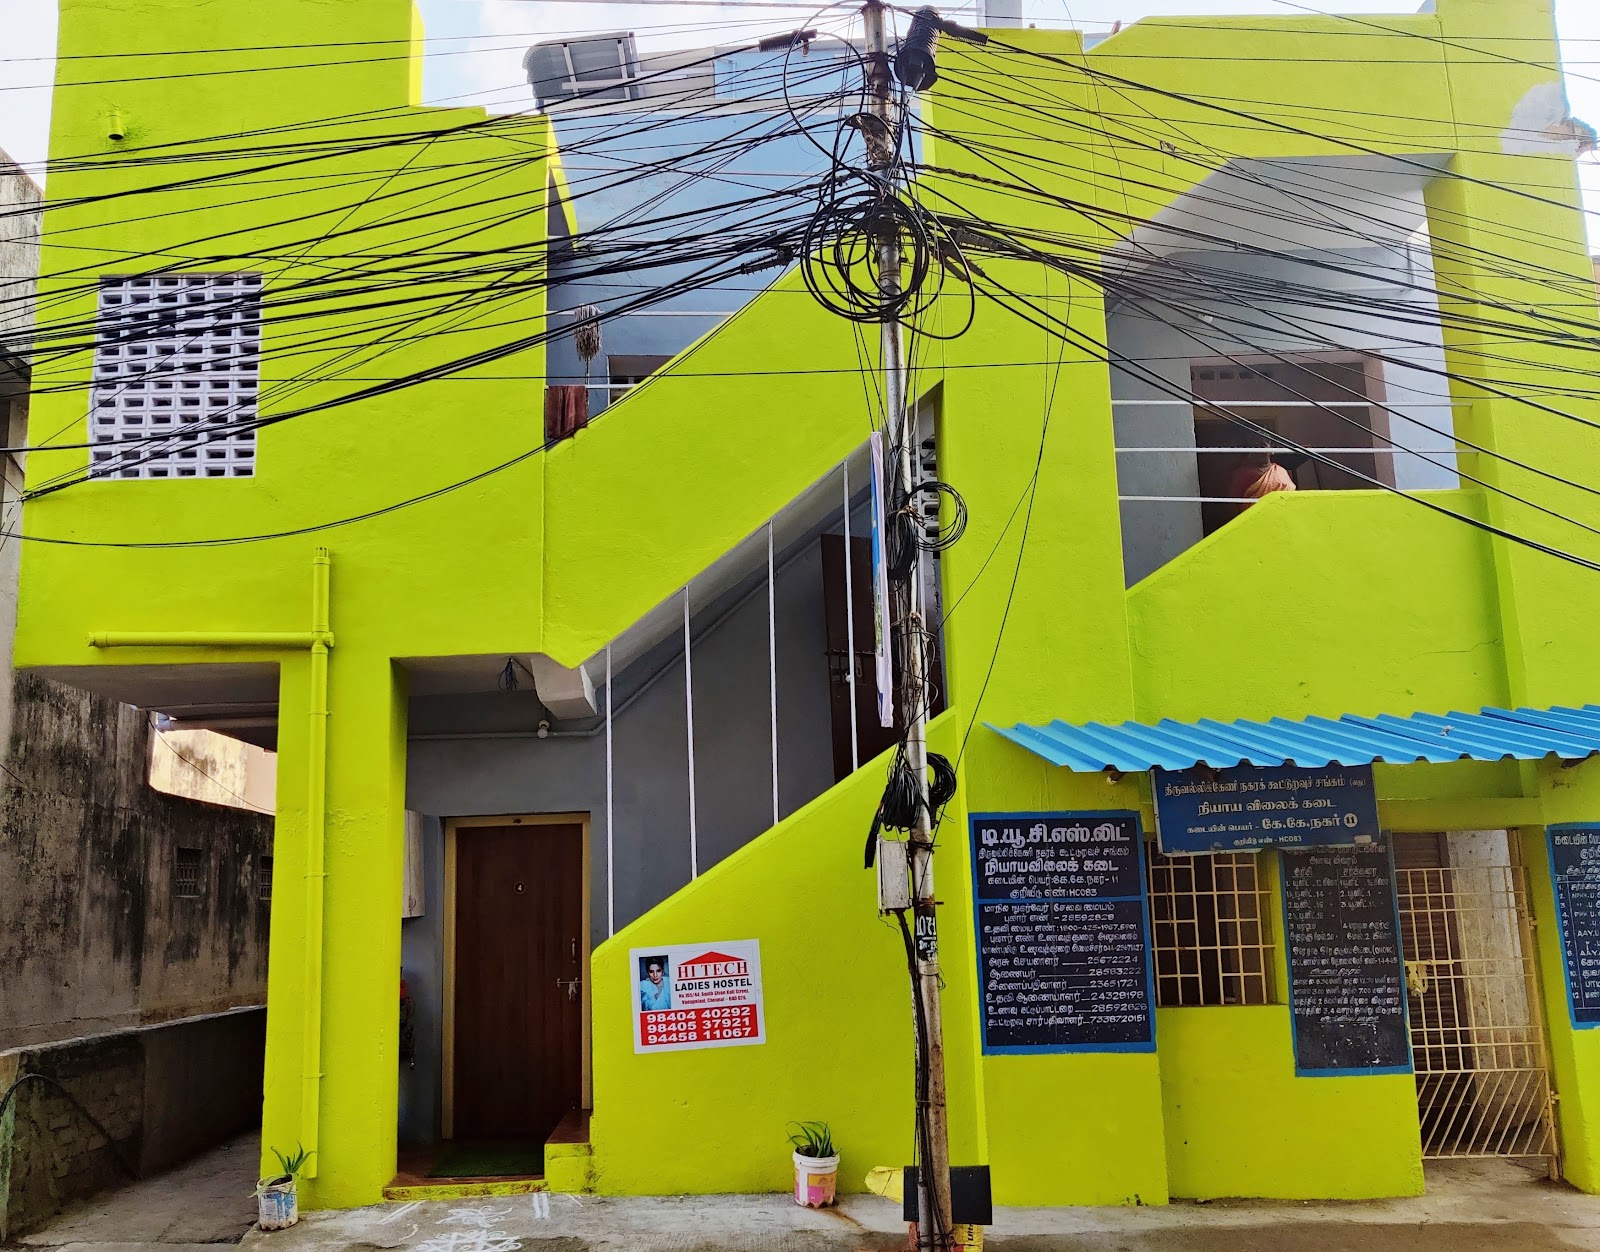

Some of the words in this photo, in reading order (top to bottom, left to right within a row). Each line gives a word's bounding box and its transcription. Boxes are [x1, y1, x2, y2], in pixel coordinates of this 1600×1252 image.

[1239, 778, 1265, 793] நகரக்
[1267, 776, 1312, 793] கூட்டுறவுச்
[1315, 775, 1345, 788] சங்கம்
[1198, 801, 1242, 816] நியாய
[1246, 797, 1299, 811] விலைக்
[1302, 799, 1336, 808] கடை
[1187, 824, 1226, 834] கடையின்
[1228, 822, 1253, 832] பெயர்
[1262, 814, 1340, 831] கே.கே.நகர்
[1103, 845, 1129, 856] சங்கம்
[985, 857, 1079, 876] நியாயவிலைக்
[1083, 859, 1118, 871] கடை
[988, 874, 1025, 885] கடையின்
[1010, 886, 1042, 898] குறியீடு
[984, 903, 1008, 914] மாநில
[1053, 902, 1081, 913] சேவை
[1083, 901, 1114, 912] மையம்
[1004, 914, 1027, 924] புகார்
[1029, 913, 1049, 922] எண்
[984, 923, 1009, 934] உதவி
[989, 934, 1013, 944] புகார்
[1015, 933, 1035, 943] எண்
[988, 957, 1010, 968] அரசு
[1013, 955, 1059, 967] செயலாளர்
[678, 965, 695, 978] HI
[701, 962, 748, 976] TECH
[989, 967, 1036, 979] ஆணையர்
[675, 981, 709, 991] LADIES
[713, 978, 752, 988] HOSTEL
[986, 993, 1014, 1005] உதவி
[647, 1011, 696, 1023] 98404
[701, 1007, 750, 1018] 40292
[988, 1005, 1017, 1015] உணவு
[647, 1021, 696, 1033] 98405
[702, 1017, 750, 1029] 37921
[648, 1031, 697, 1044] 94458
[703, 1027, 751, 1039] 11067
